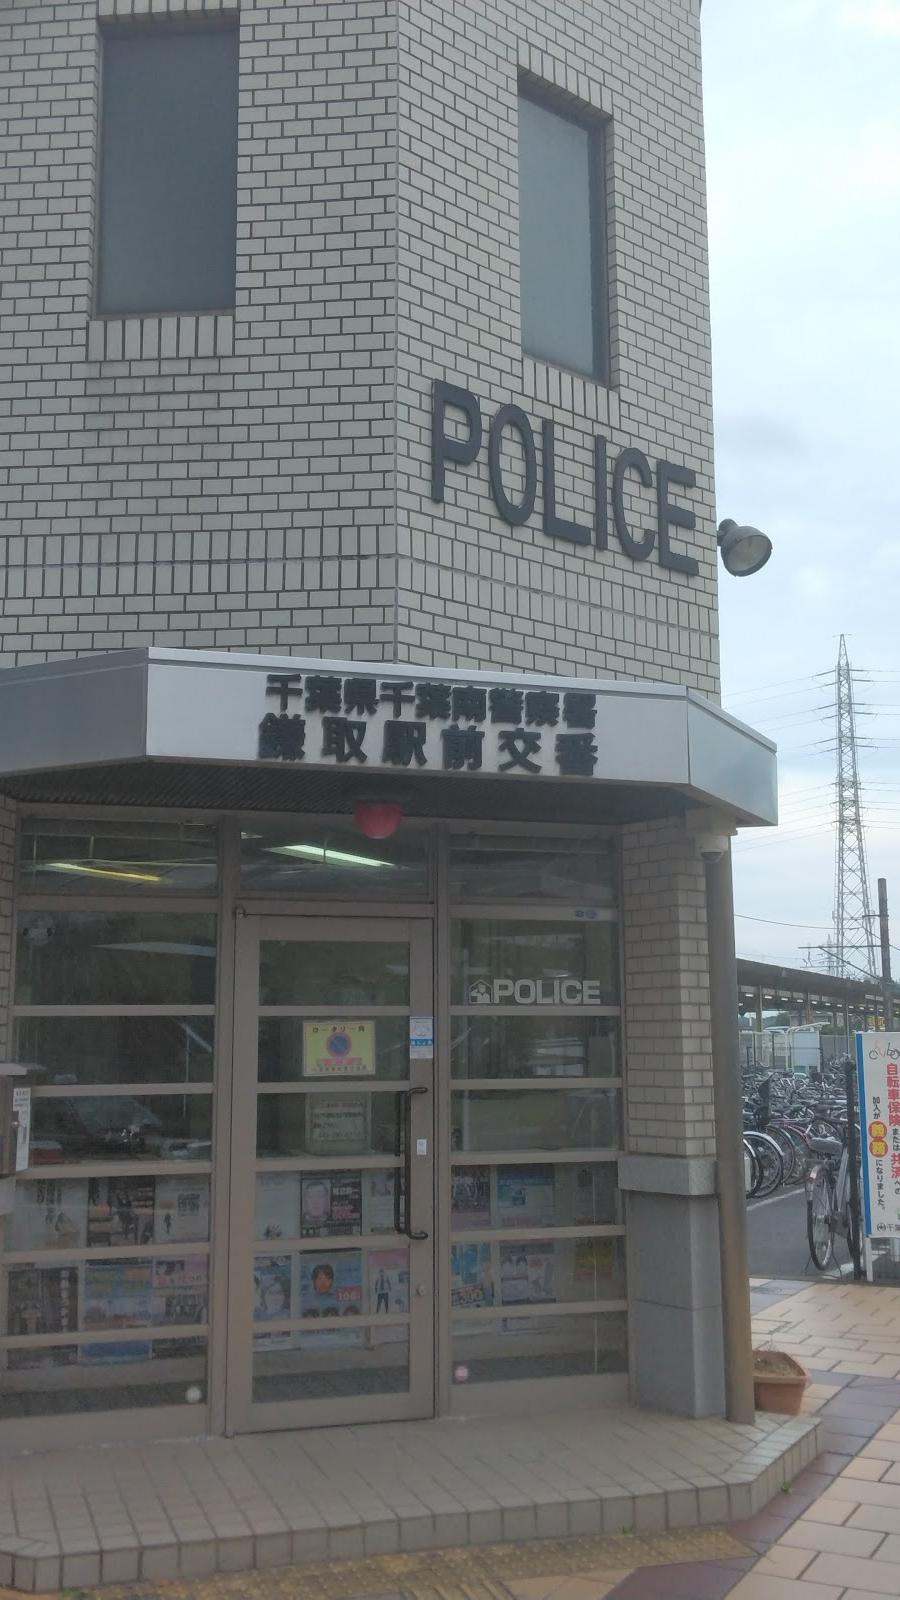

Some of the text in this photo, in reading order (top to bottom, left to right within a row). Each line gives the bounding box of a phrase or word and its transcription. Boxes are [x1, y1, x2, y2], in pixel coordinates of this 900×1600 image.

[431, 379, 699, 576] POLICE
[266, 673, 596, 729] 千葉県千葉南警察署
[259, 713, 598, 775] 鎌取駅前交番
[493, 979, 601, 1004] POLICE
